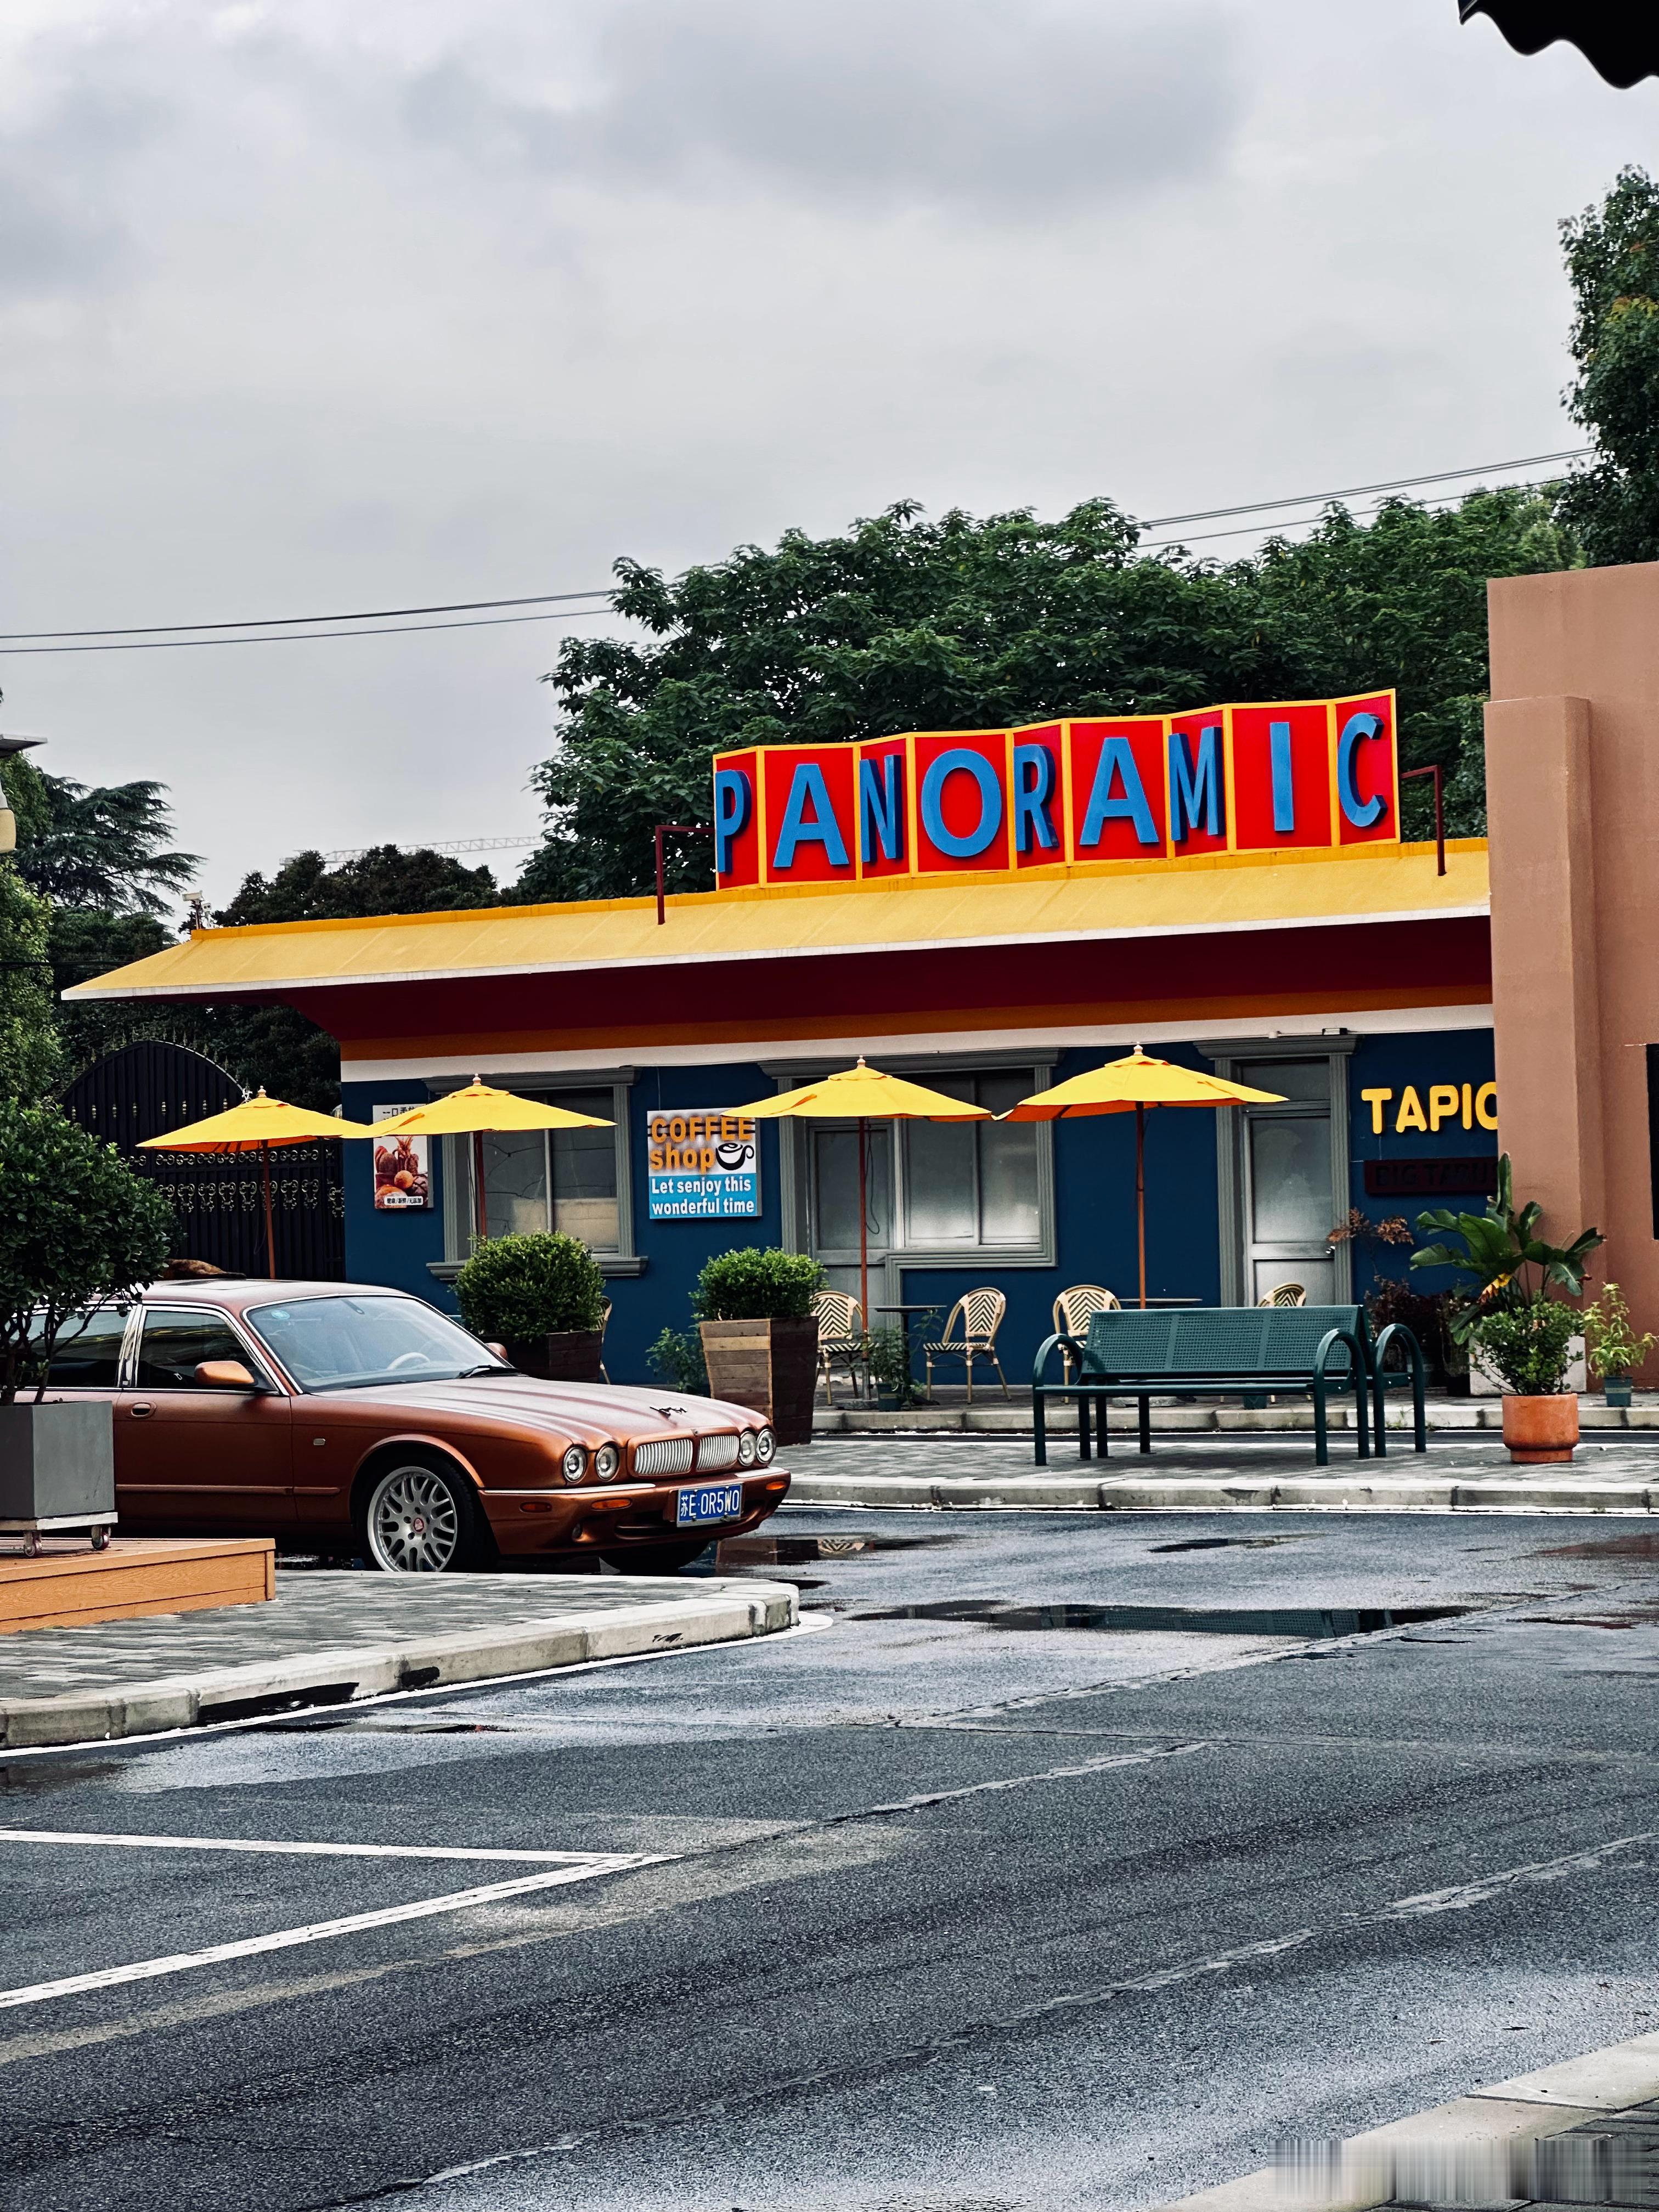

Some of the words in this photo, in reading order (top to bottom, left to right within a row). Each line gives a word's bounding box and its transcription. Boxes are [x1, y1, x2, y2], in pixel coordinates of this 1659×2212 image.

[714, 713, 1388, 873] PANORAMIC
[651, 1115, 753, 1143] COFFEE
[649, 1143, 715, 1175] shop
[651, 1178, 674, 1194] Let
[725, 1176, 752, 1192] this
[652, 1198, 720, 1215] wonderful
[724, 1198, 754, 1214] time
